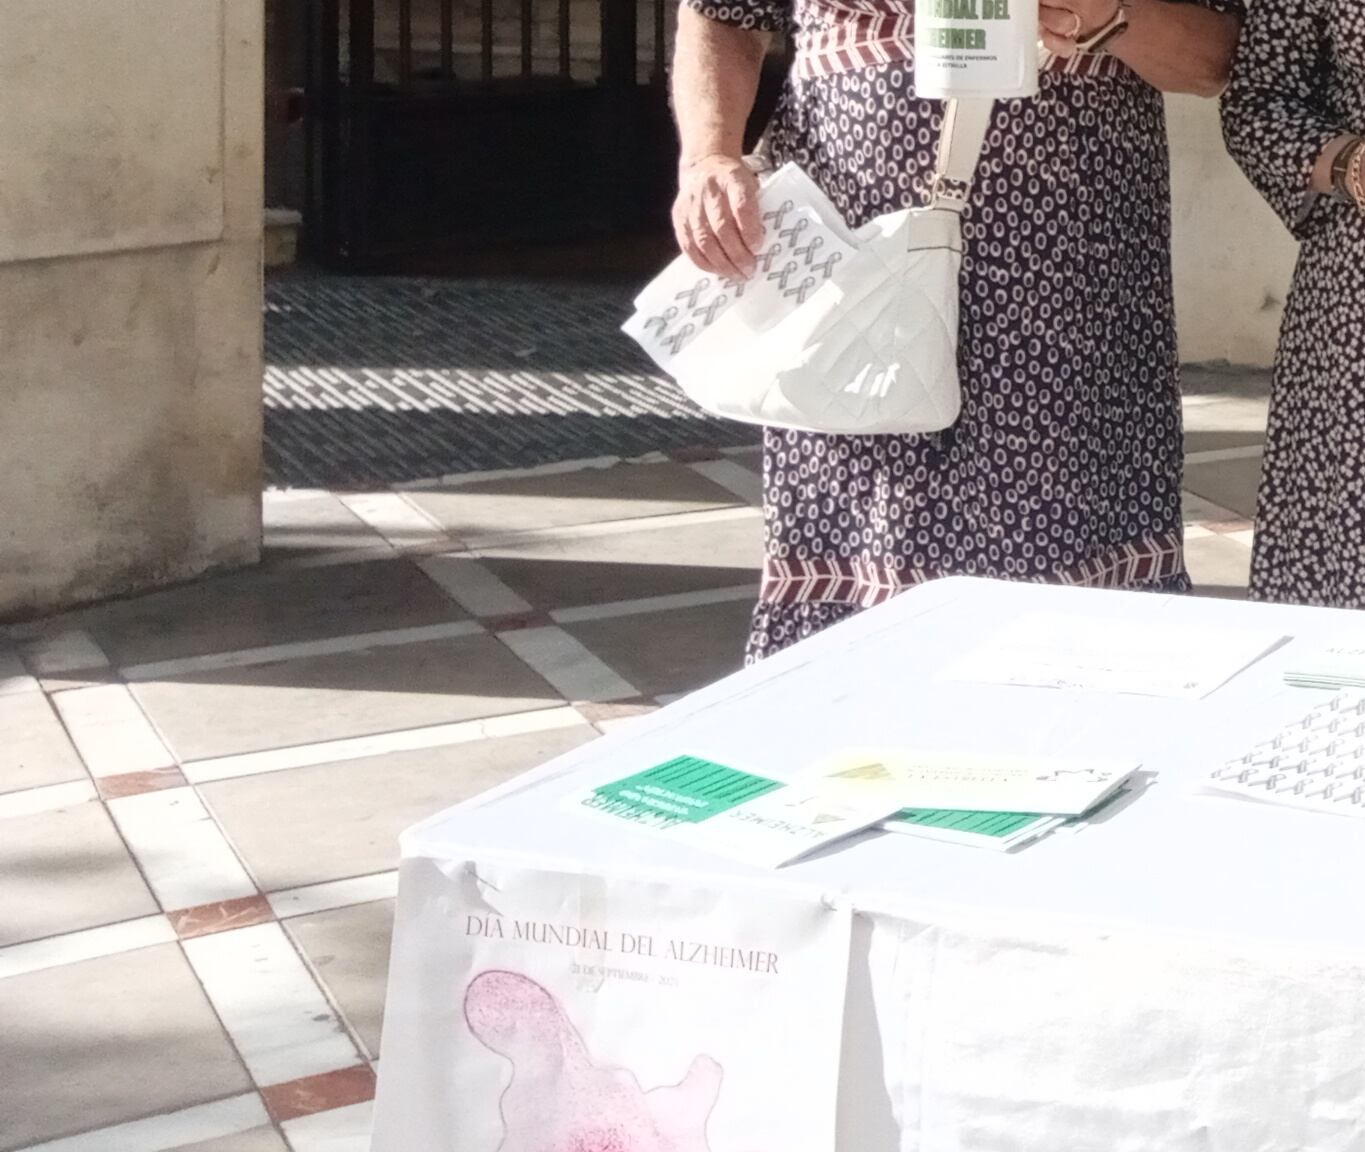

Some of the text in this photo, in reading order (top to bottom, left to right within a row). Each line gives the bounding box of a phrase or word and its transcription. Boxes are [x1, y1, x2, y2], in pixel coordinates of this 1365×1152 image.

[465, 913, 779, 975] DÍA MUNDIAL DEL ALZHEIMER
